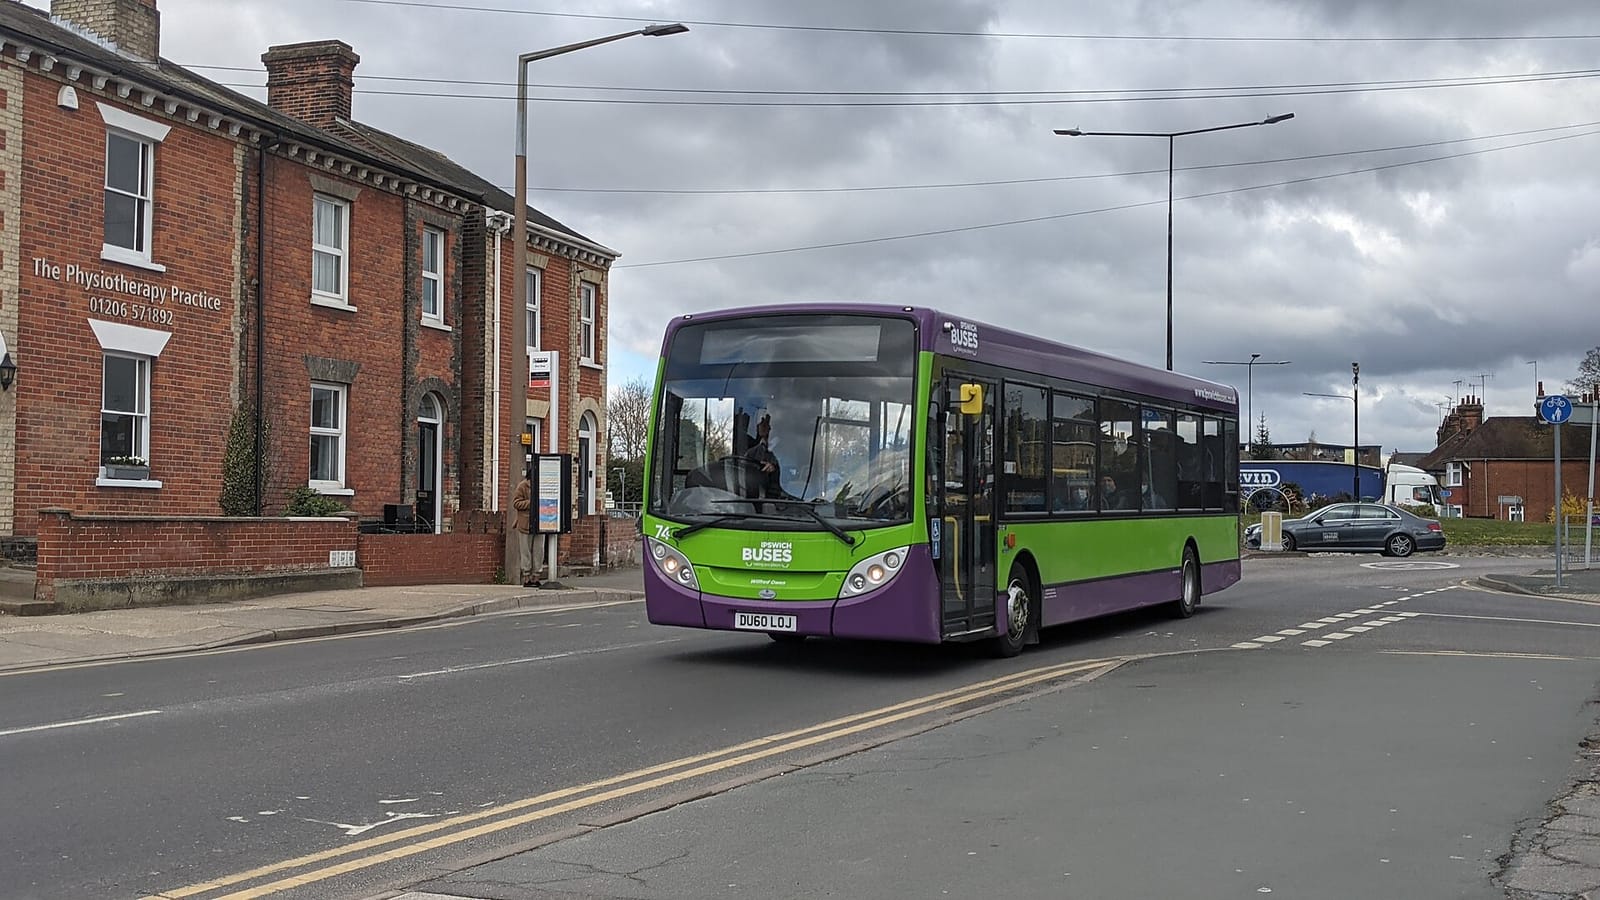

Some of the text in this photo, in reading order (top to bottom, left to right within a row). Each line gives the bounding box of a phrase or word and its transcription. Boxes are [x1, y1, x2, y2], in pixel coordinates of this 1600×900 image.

[33, 257, 221, 311] The Physiotherapy Practice
[89, 297, 174, 326] 01206 571892
[951, 329, 978, 349] BUSES
[760, 541, 792, 550] IPSWICH
[742, 548, 792, 563] BUSES
[739, 615, 792, 629] DU60 LOJ
